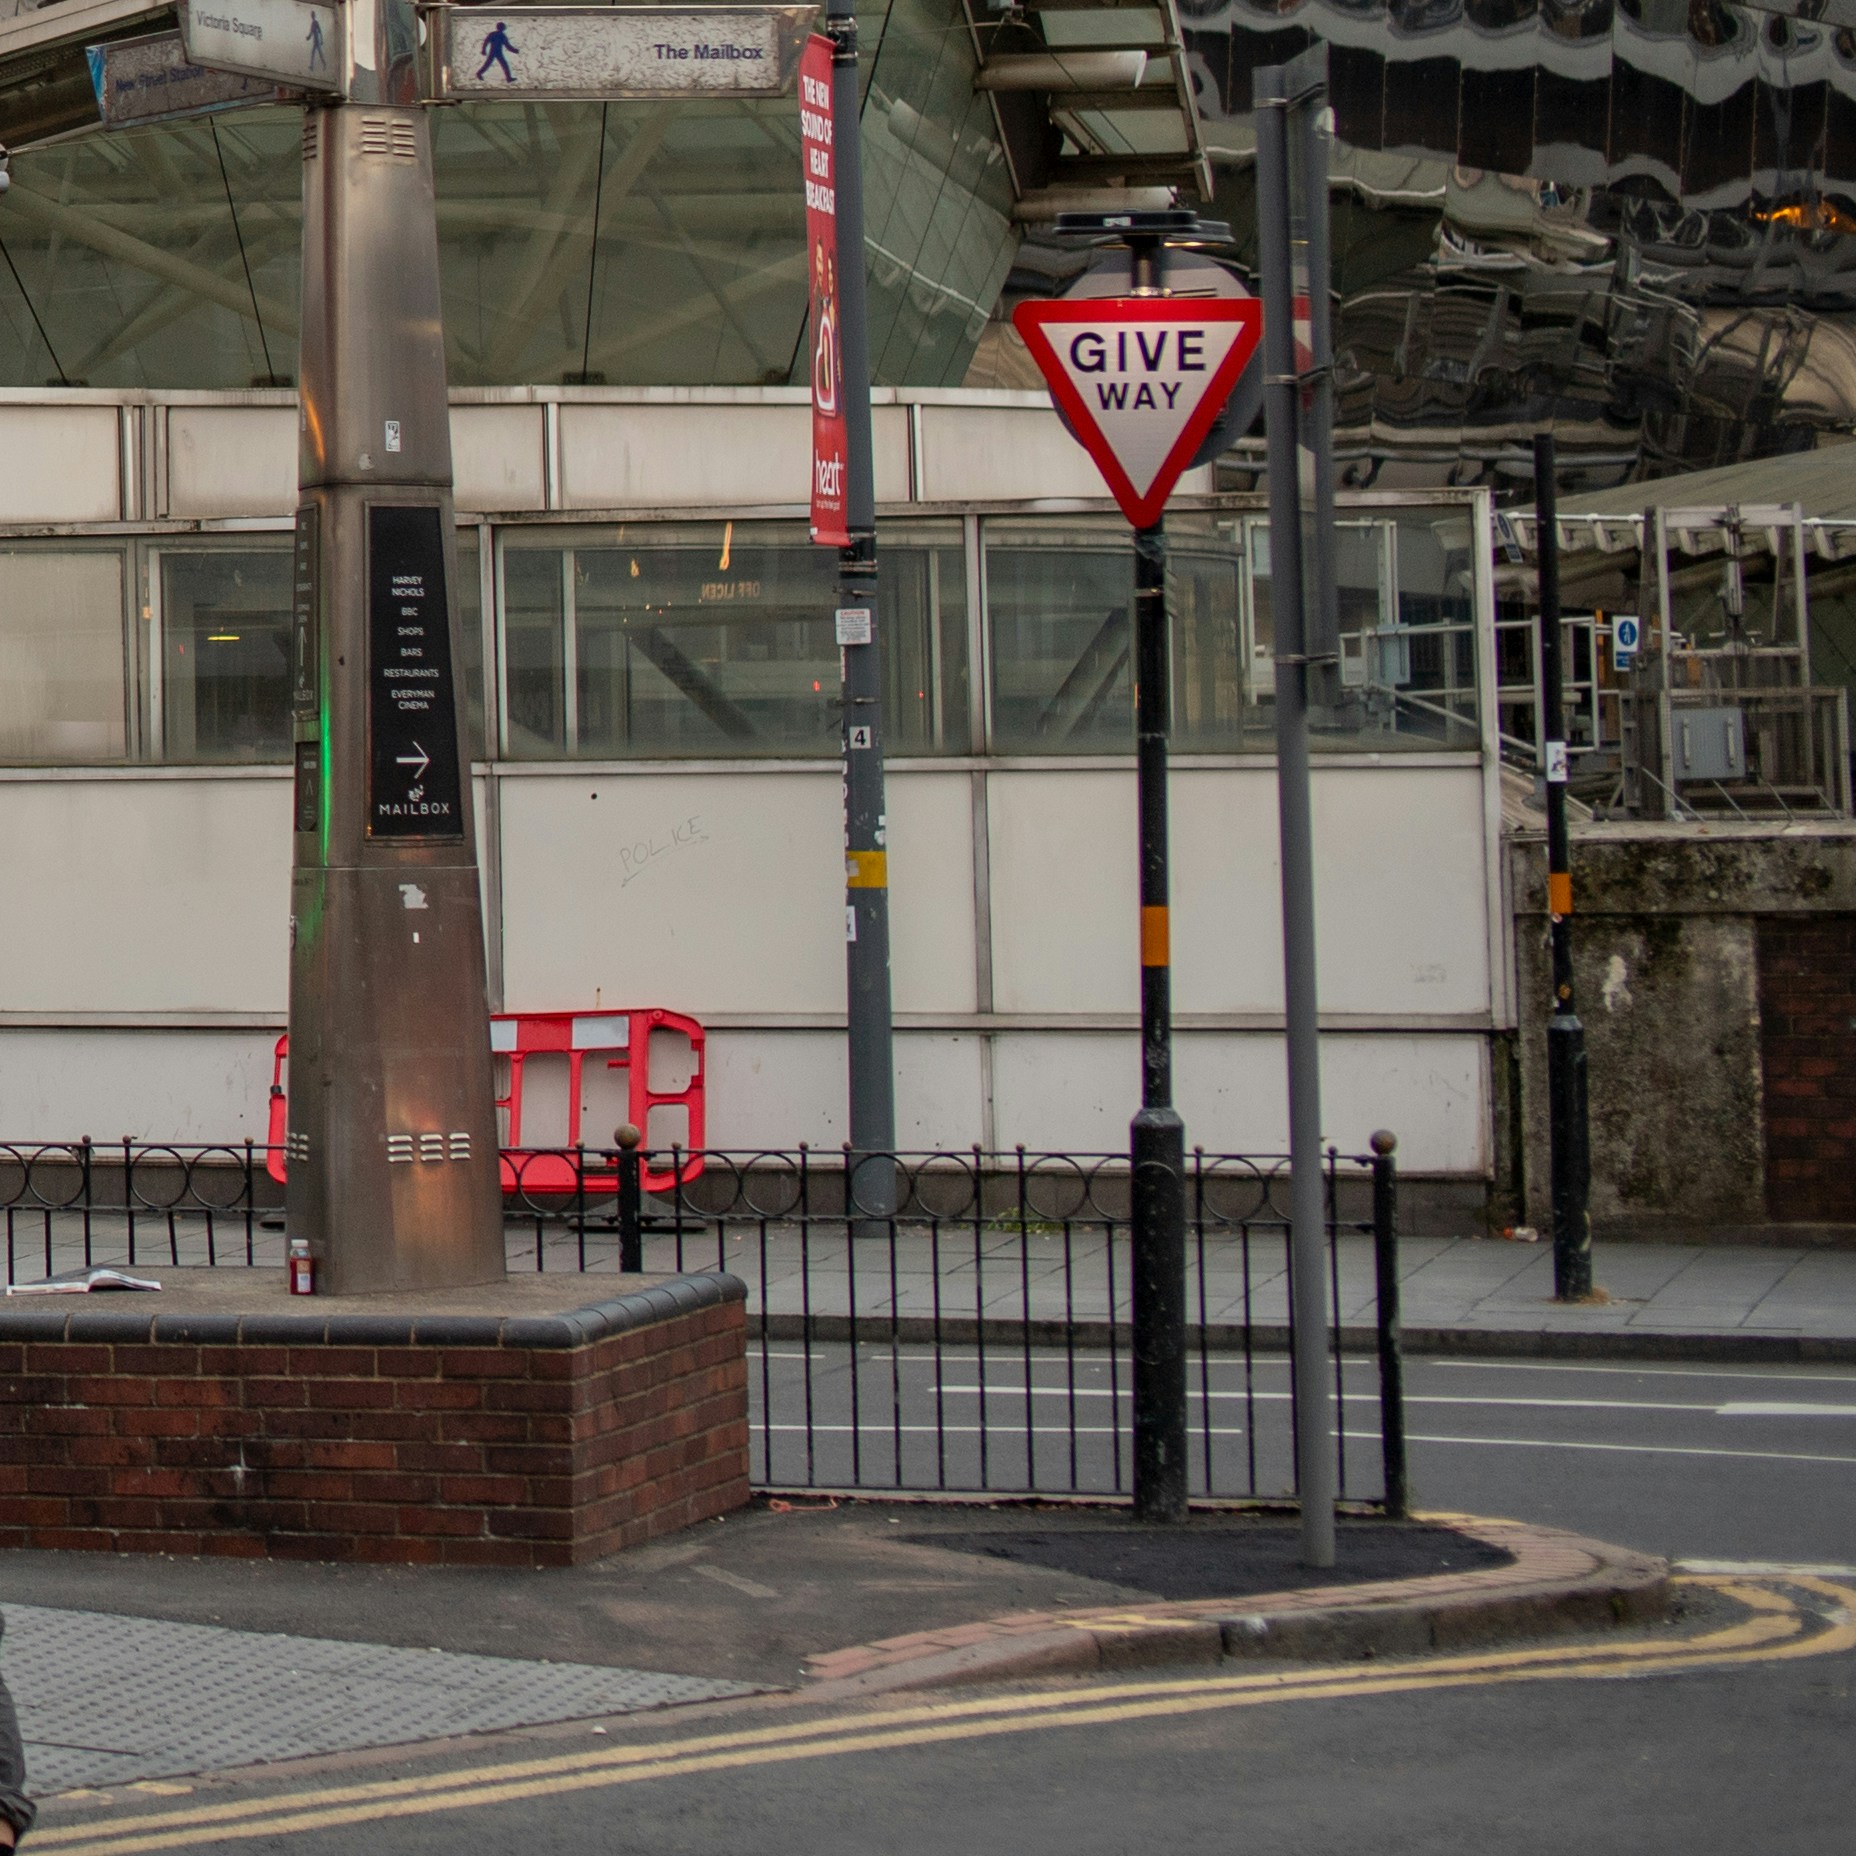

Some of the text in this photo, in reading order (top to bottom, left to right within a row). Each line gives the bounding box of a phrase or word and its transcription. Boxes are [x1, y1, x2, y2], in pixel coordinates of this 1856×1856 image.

[196, 9, 263, 41] Victoria Square
[654, 43, 763, 60] The Mailbox
[802, 75, 830, 110] THE NEW
[801, 109, 833, 145] SOUND OF
[809, 148, 829, 178] HEART
[805, 179, 835, 215] BREAKFAST
[1070, 330, 1206, 373] GIVE
[1096, 382, 1183, 410] WAY
[815, 448, 841, 496] heart
[392, 576, 423, 585] HARVEY
[392, 587, 425, 597] NICHOLS
[401, 607, 418, 616] BBC
[397, 627, 424, 636] SHOPS
[401, 647, 423, 657] BARS
[384, 668, 439, 678] RESTAURANTS
[391, 689, 435, 699] EVERYMAN
[398, 700, 430, 710] CINEMA
[854, 729, 865, 745] 4
[379, 802, 450, 815] MAILBOX
[619, 815, 702, 872] POLICE
